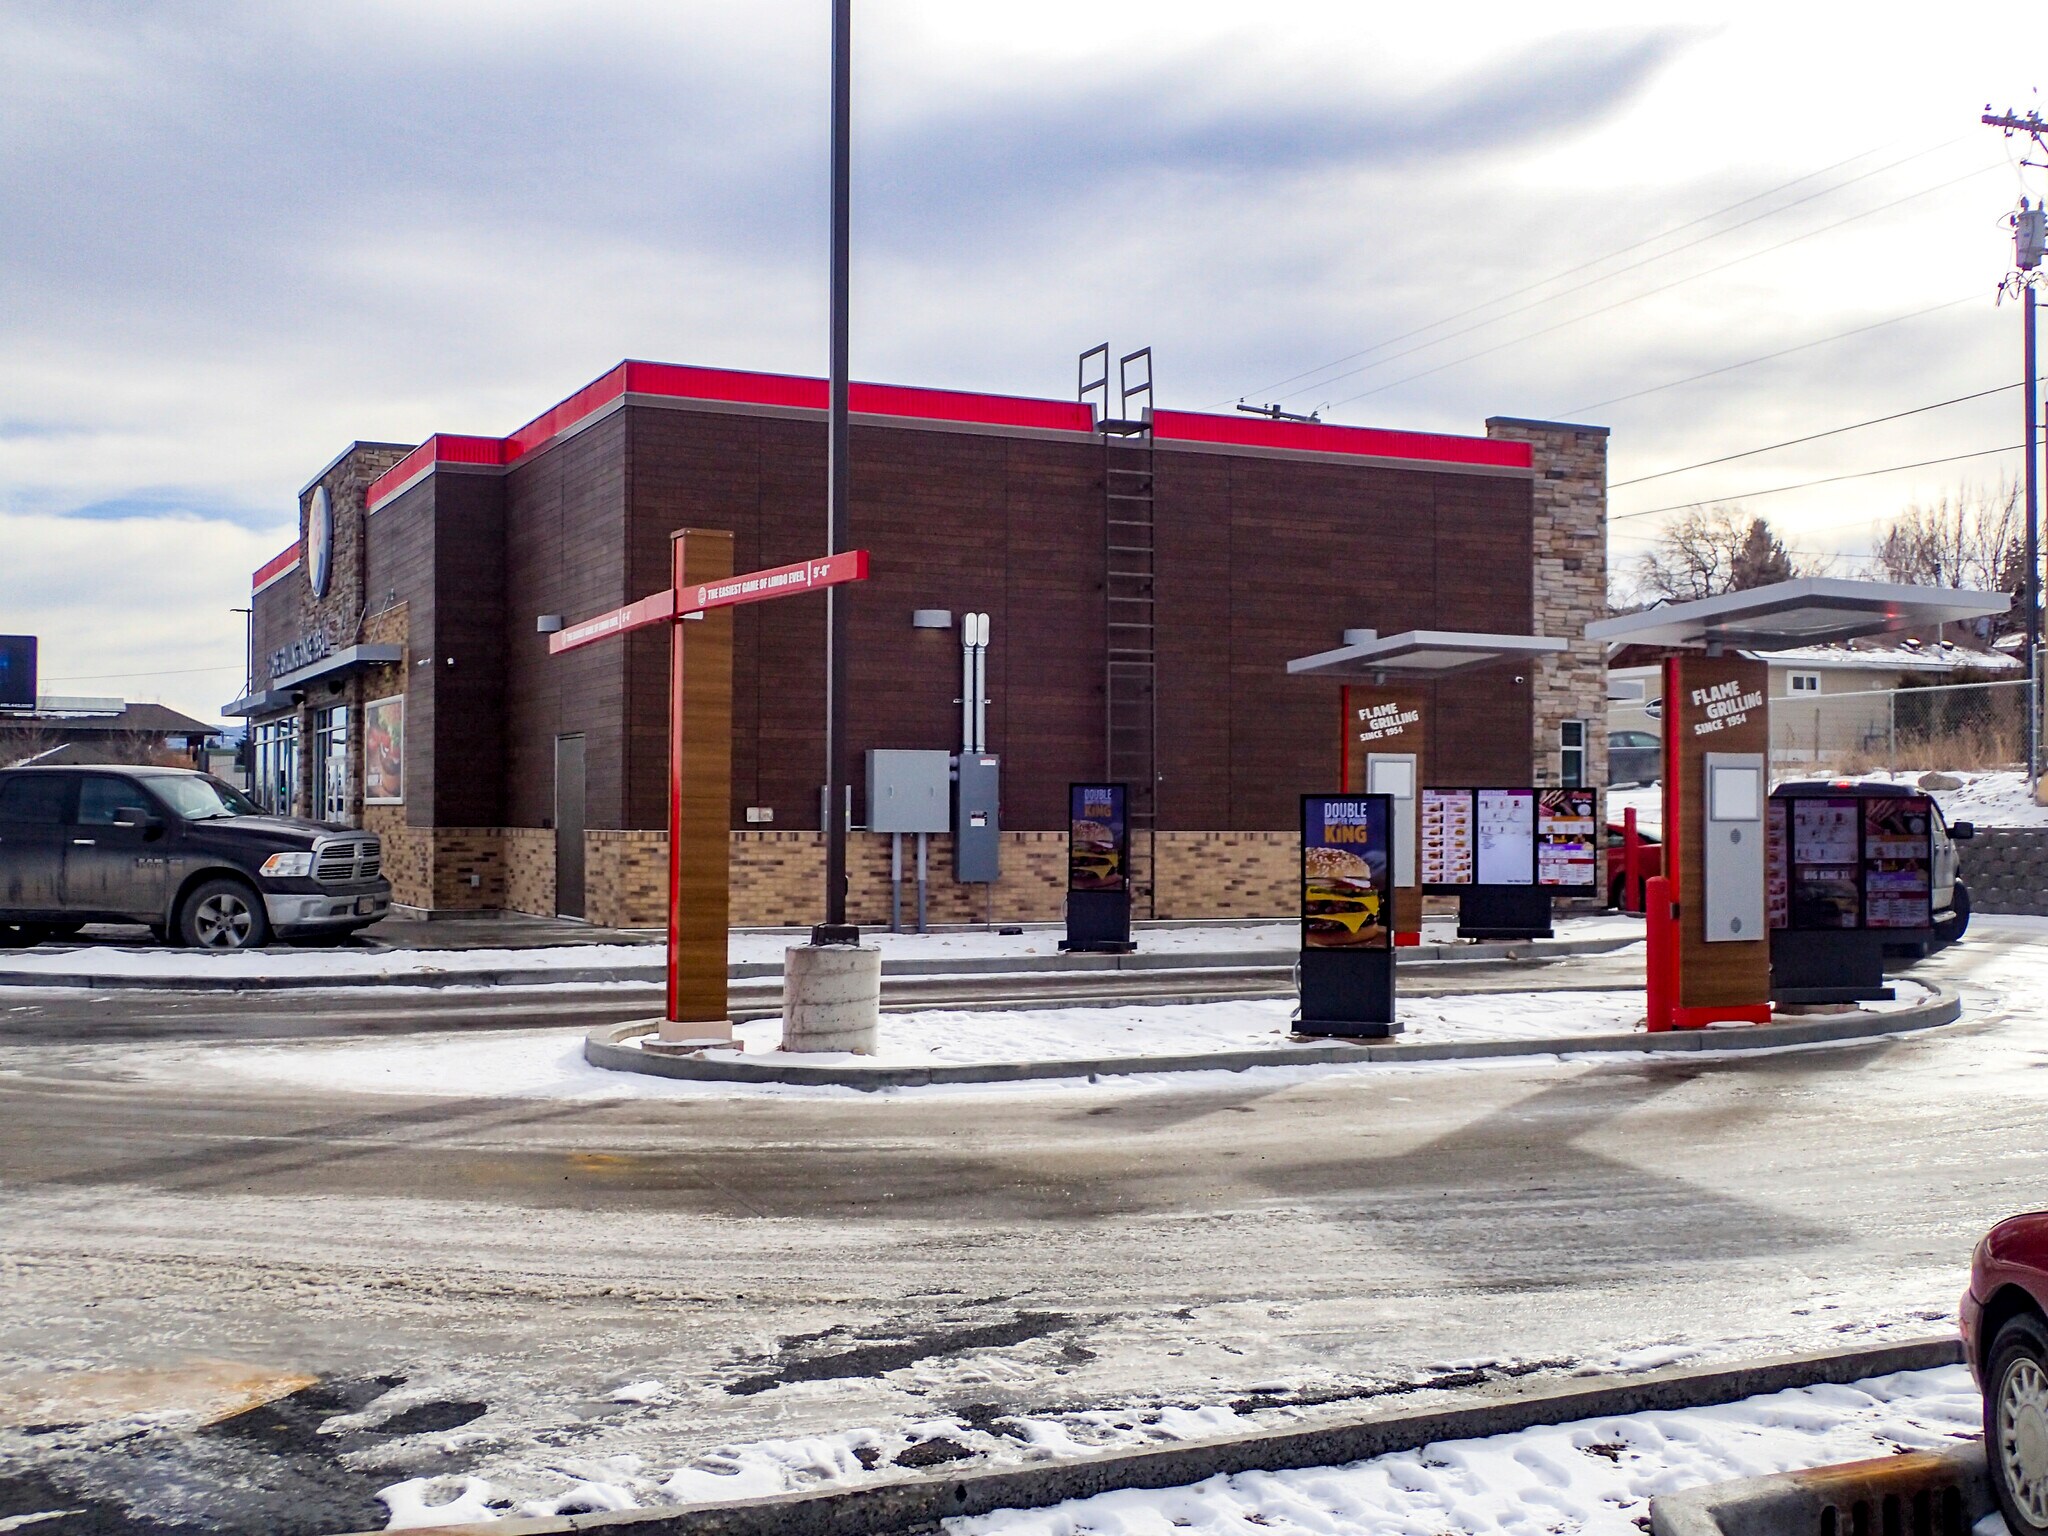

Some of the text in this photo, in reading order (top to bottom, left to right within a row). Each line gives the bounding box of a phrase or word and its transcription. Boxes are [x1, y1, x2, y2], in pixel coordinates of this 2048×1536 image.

[707, 589, 719, 600] THE
[719, 583, 742, 598] EASIEST
[742, 579, 760, 594] GAME
[759, 577, 767, 589] OF
[768, 573, 788, 588] LIMBO
[788, 570, 806, 584] EVER.
[1691, 680, 1741, 706] FLAME
[1358, 702, 1398, 720] FLAME
[1706, 690, 1763, 719] GRILLING
[1369, 710, 1419, 730] GRILLING
[1694, 713, 1747, 735] SINCE 1954
[1359, 725, 1404, 742] SINCE 1954
[1084, 788, 1112, 800] DOUBLE
[1324, 802, 1367, 818] DOUBLE
